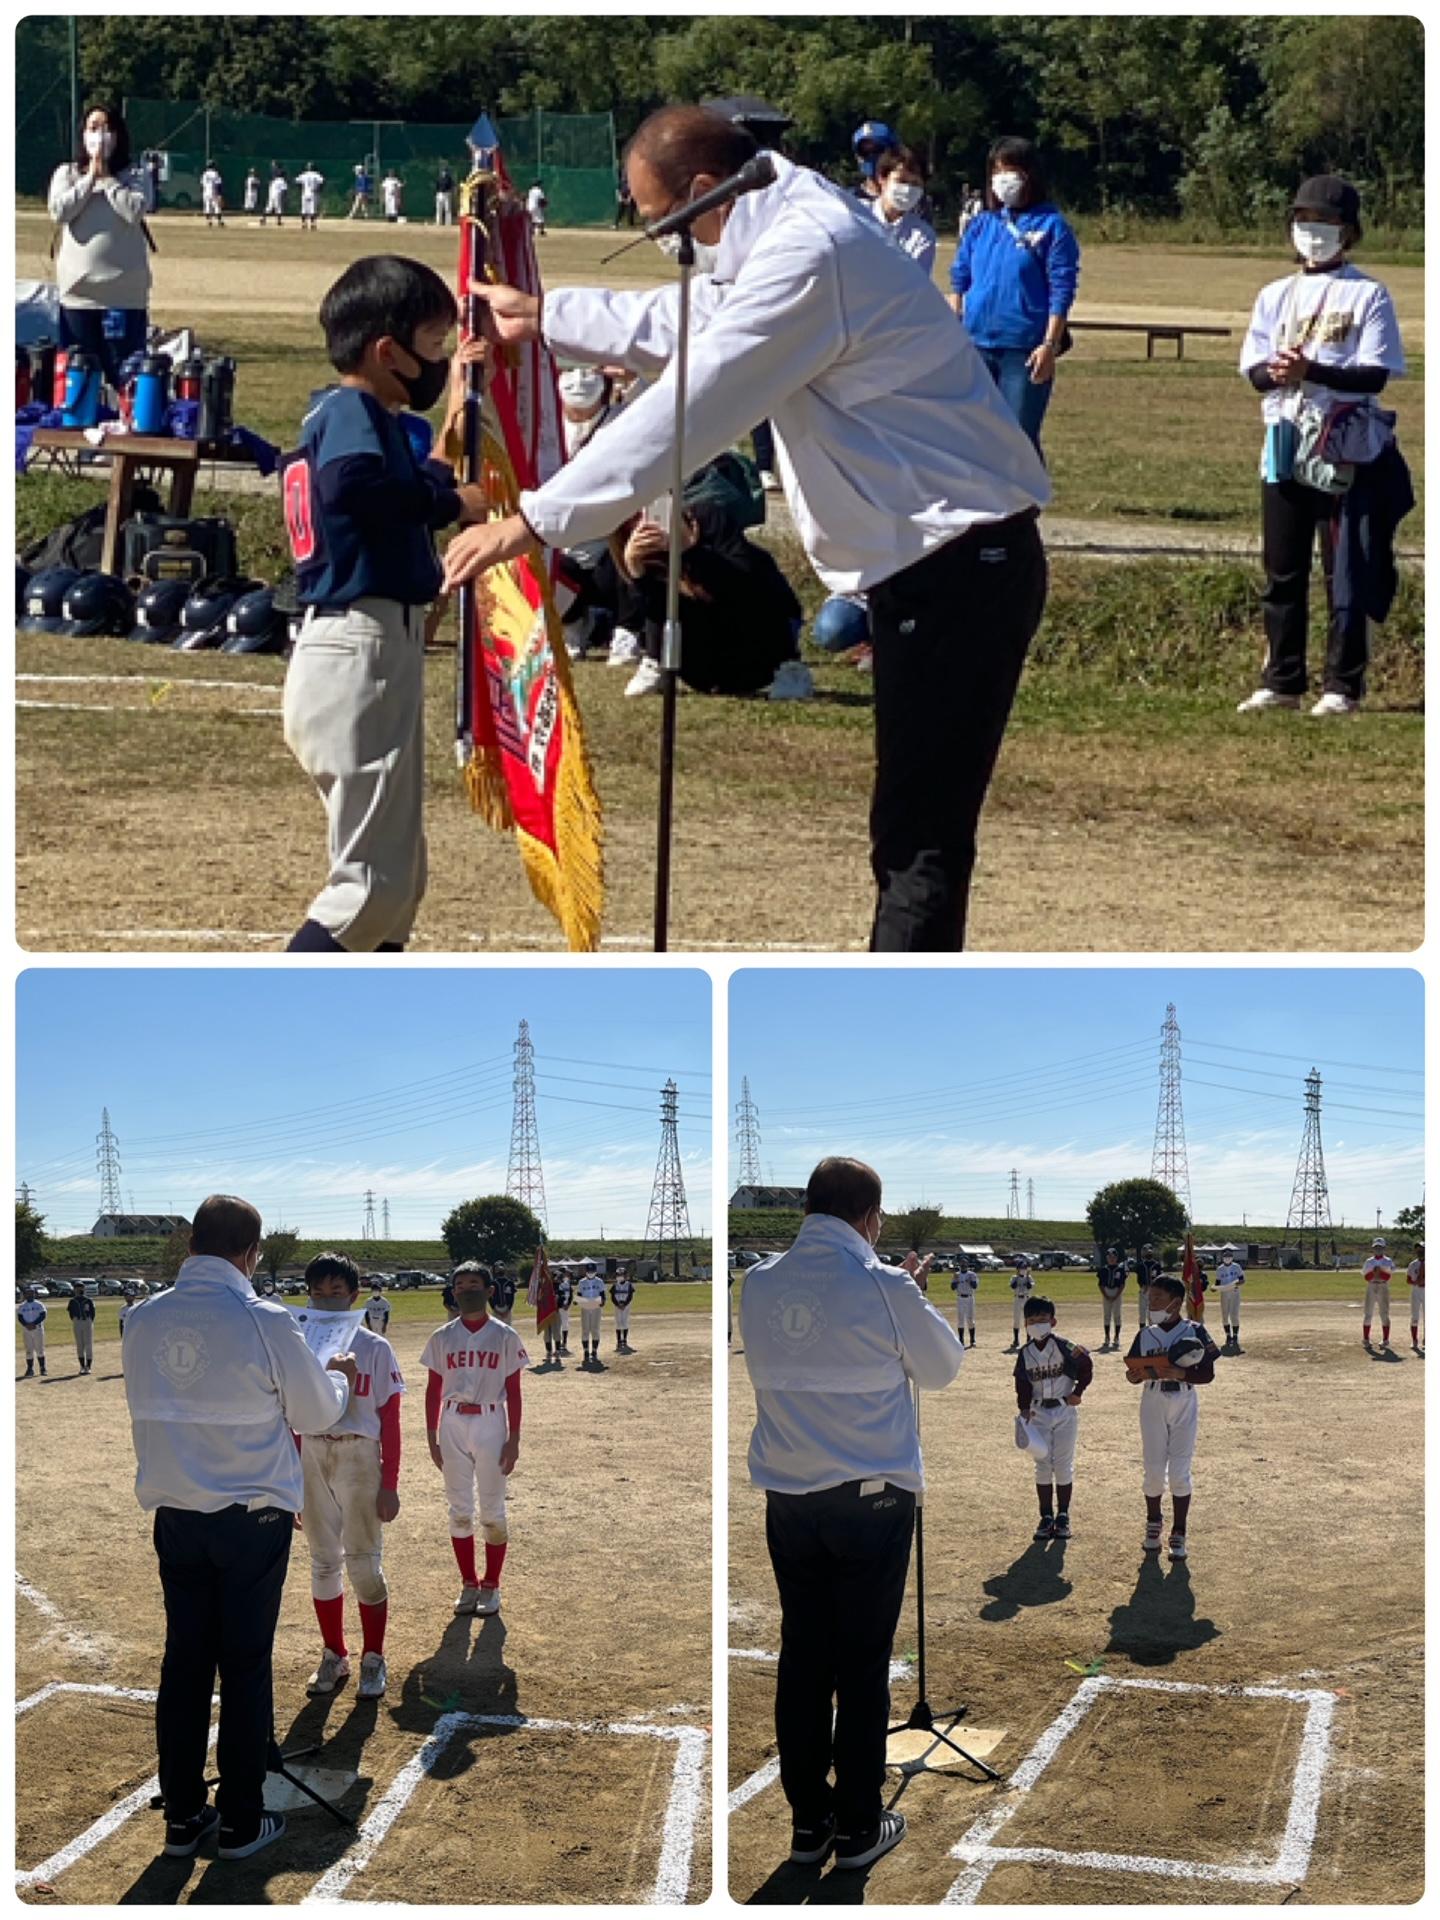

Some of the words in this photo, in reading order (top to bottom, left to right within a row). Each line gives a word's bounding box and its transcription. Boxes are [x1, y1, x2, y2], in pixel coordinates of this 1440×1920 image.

[788, 1308, 805, 1332] L
[175, 1344, 190, 1369] L
[446, 1350, 500, 1370] KEIYU
